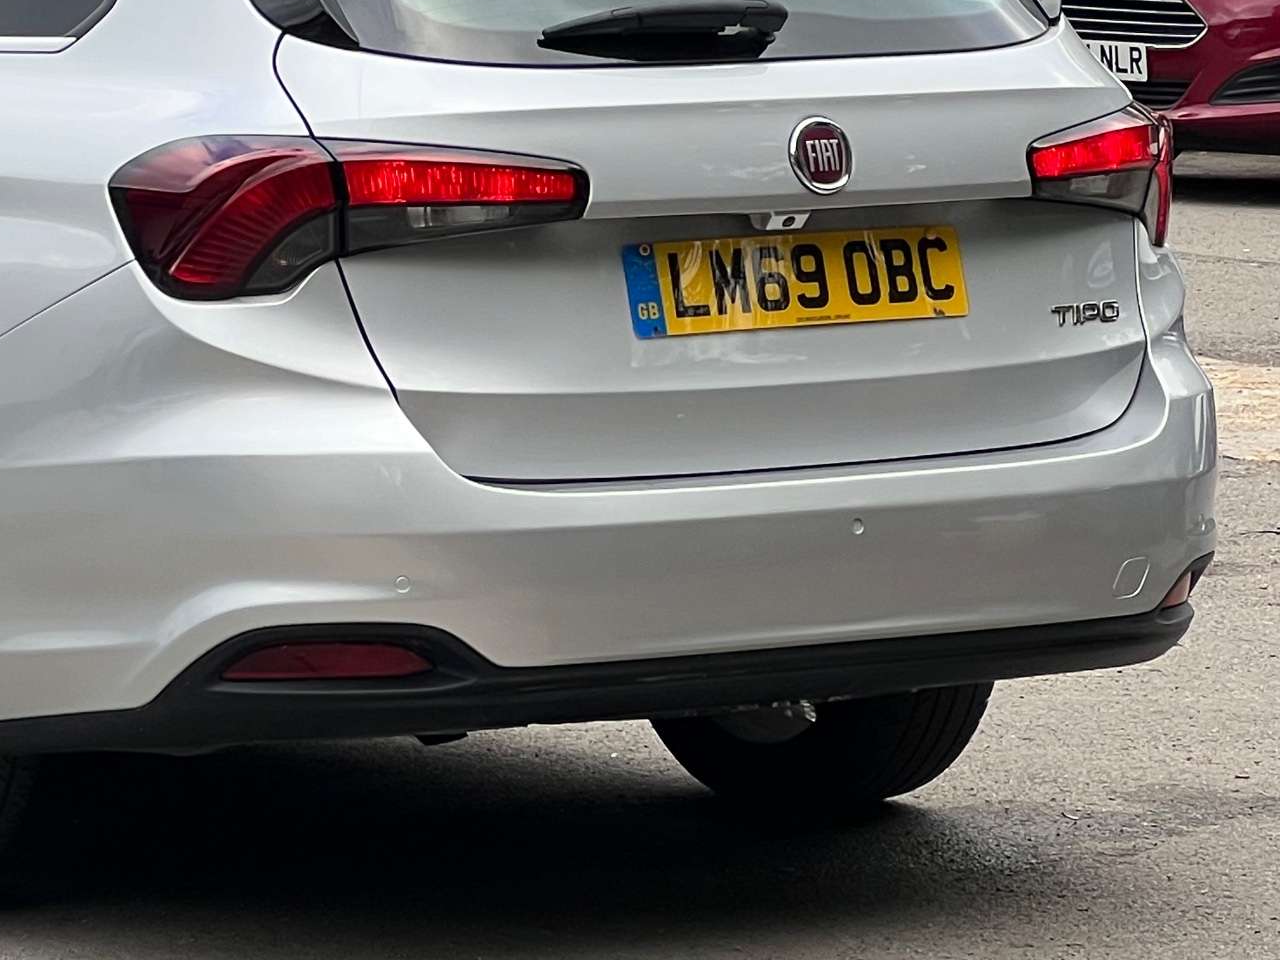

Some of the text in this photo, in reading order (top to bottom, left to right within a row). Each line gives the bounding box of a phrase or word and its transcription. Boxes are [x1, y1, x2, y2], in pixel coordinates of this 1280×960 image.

[805, 138, 838, 173] FIAT
[668, 236, 955, 319] LM69 OBC
[638, 302, 660, 320] GB
[1050, 300, 1120, 327] TIPO
